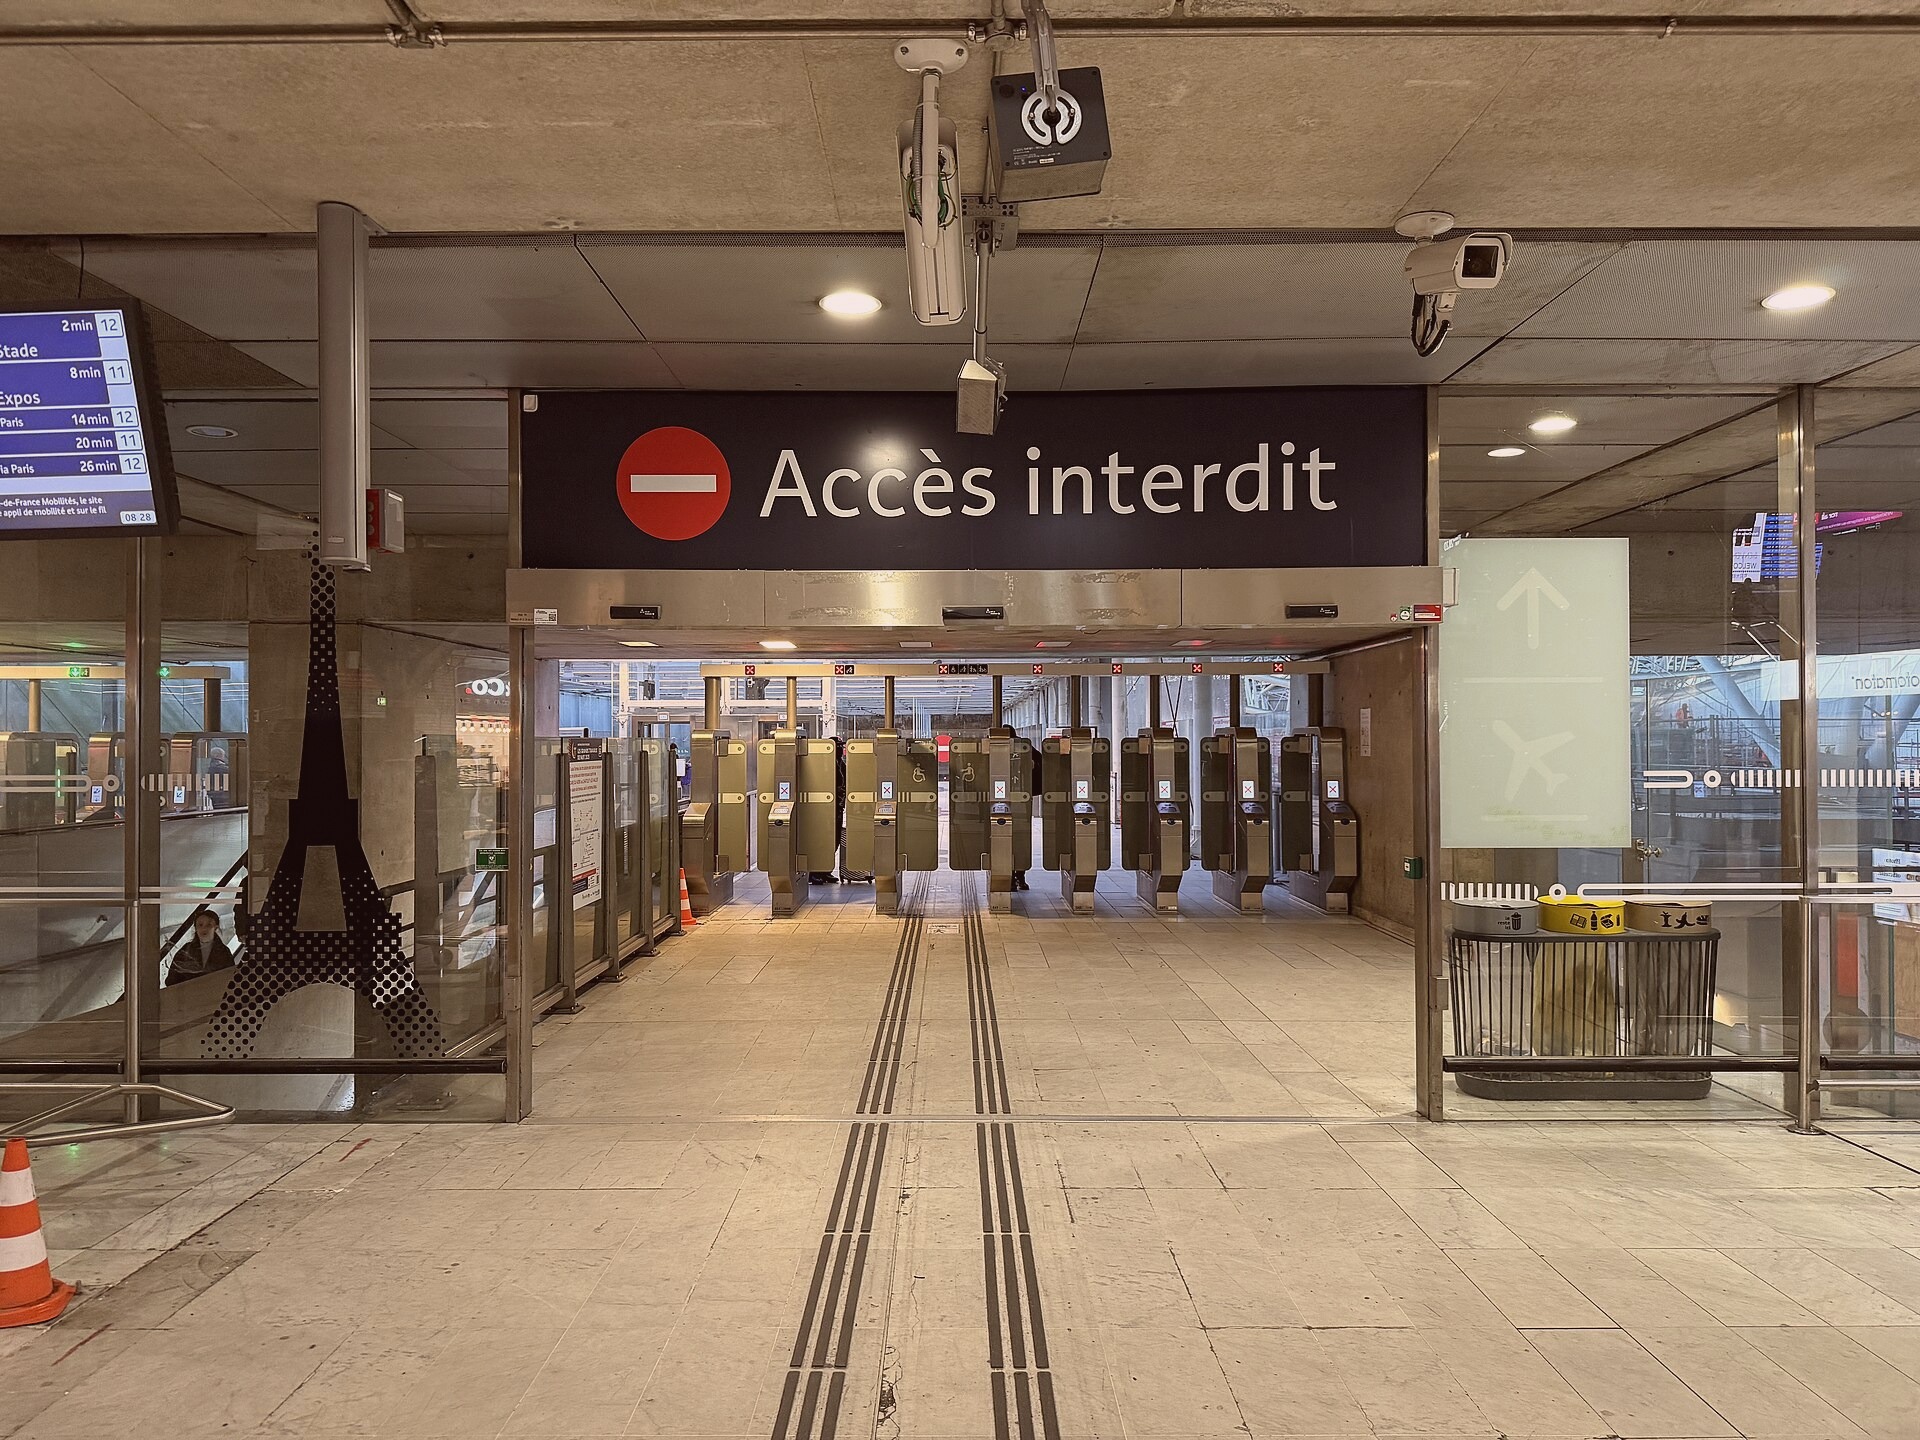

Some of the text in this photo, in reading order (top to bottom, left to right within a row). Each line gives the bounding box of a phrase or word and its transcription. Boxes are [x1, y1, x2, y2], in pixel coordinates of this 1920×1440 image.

[101, 318, 118, 331] 12
[108, 366, 124, 378] 11
[0, 391, 40, 408] Expos
[0, 417, 24, 427] Paris
[116, 411, 133, 423] 12
[120, 434, 136, 446] 11
[11, 464, 34, 474] Paris
[124, 458, 141, 470] 12
[759, 442, 1338, 518] Accès interdit
[79, 496, 87, 504] le
[88, 496, 102, 504] site
[3, 508, 22, 518] appli
[23, 508, 33, 516] de
[34, 507, 66, 515] mobilité
[67, 507, 75, 515] et
[89, 506, 97, 514] le
